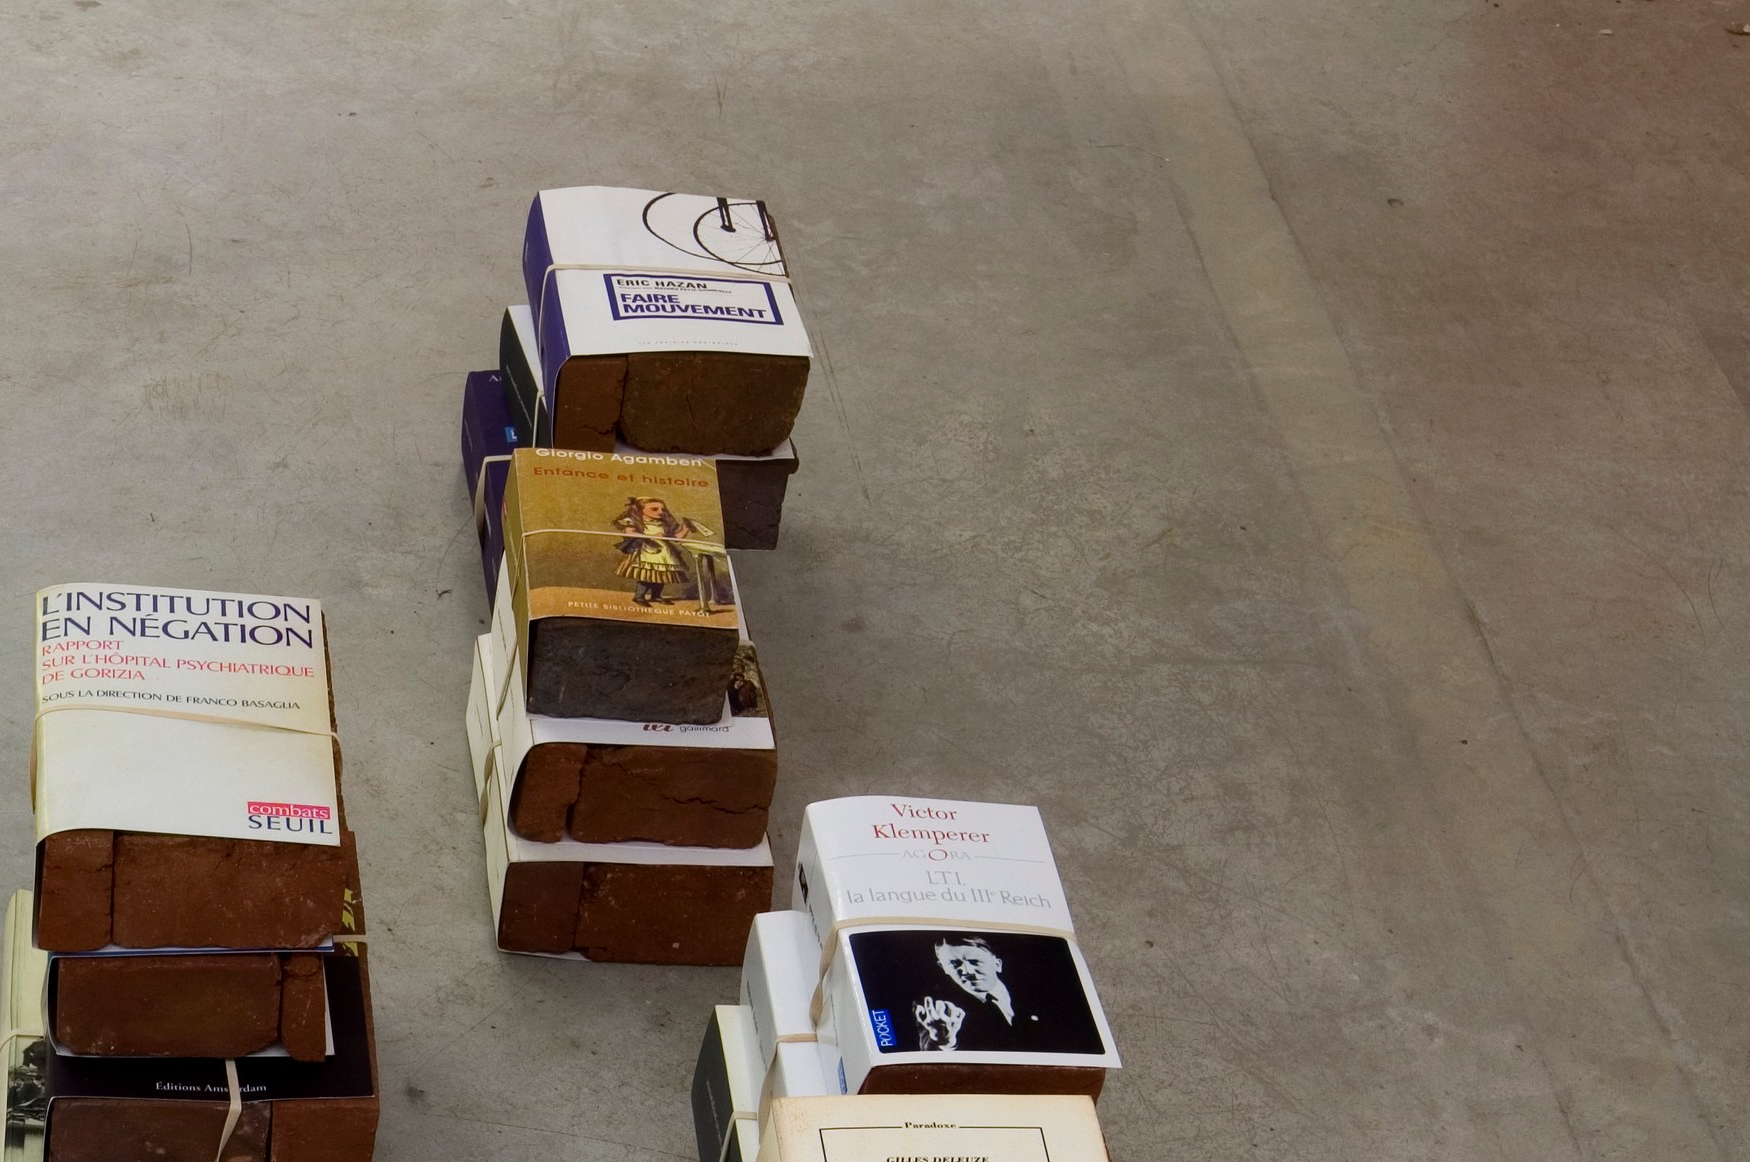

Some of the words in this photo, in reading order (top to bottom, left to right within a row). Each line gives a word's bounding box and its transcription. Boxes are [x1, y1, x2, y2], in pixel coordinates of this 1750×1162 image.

[616, 279, 650, 287] ERIC
[655, 281, 708, 290] HAZAN
[620, 293, 681, 304] FAIRE
[623, 304, 767, 319] MOUVEMENT
[535, 448, 604, 461] Giorgio
[611, 453, 702, 467] Agamben
[533, 466, 610, 480] Enfance
[616, 473, 634, 482] et
[642, 475, 710, 488] histoire
[42, 591, 311, 624] L'INSTITUTION
[568, 601, 598, 609] PETITE
[679, 608, 711, 618] PAYOT
[42, 616, 91, 642] EN
[109, 614, 313, 649] NÉGATION
[42, 640, 124, 656] RAPPORT
[42, 655, 75, 671] SUR
[82, 652, 171, 669] L'HÔPITAL
[177, 660, 315, 678] PSYCHIATRIQUE
[42, 670, 65, 685] DE
[71, 668, 146, 681] GORIZIA
[42, 690, 75, 704] SOUS
[78, 689, 93, 698] LA
[96, 689, 162, 701] DIRECTION
[166, 694, 183, 703] DE
[186, 696, 238, 707] FRANCO
[241, 699, 301, 710] BASAGLIA
[249, 804, 329, 819] combats
[891, 803, 958, 820] Victor
[248, 814, 333, 835] SEUIL
[872, 823, 990, 845] Klemperer
[902, 849, 971, 861] AGORA
[847, 890, 865, 904] la
[869, 888, 937, 904] langue
[941, 888, 966, 902] du
[1001, 890, 1052, 909] Reich
[872, 1009, 893, 1046] POCKET
[204, 1084, 267, 1093] Amsrdam
[904, 1121, 957, 1129] Paradoxe
